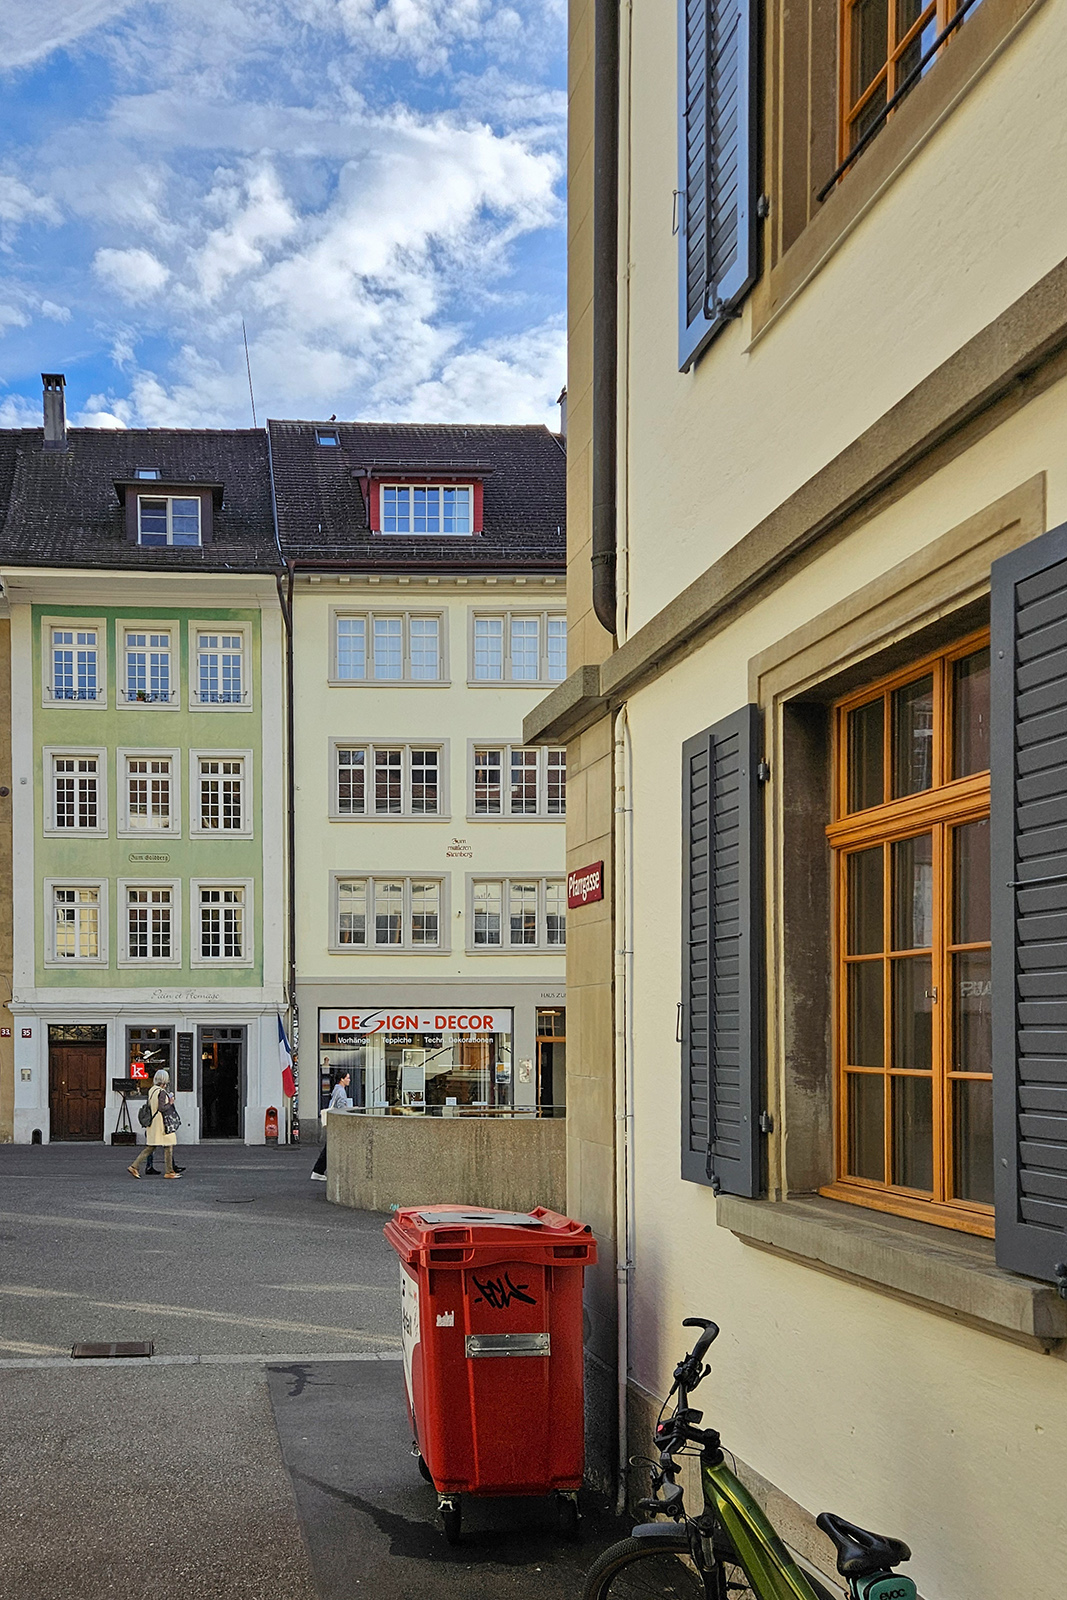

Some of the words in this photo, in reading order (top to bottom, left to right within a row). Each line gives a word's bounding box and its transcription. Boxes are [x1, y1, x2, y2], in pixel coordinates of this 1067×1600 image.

[568, 871, 600, 902] Pfarrgasse
[338, 1010, 419, 1037] DESIGN
[434, 1015, 494, 1030] DECOR
[1, 1028, 11, 1036] 33
[22, 1029, 31, 1037] 35
[338, 1036, 371, 1044] Vorhänge
[382, 1036, 412, 1044] Teppiche
[448, 1036, 494, 1044] Dekorationen
[879, 1588, 906, 1600] evoc
